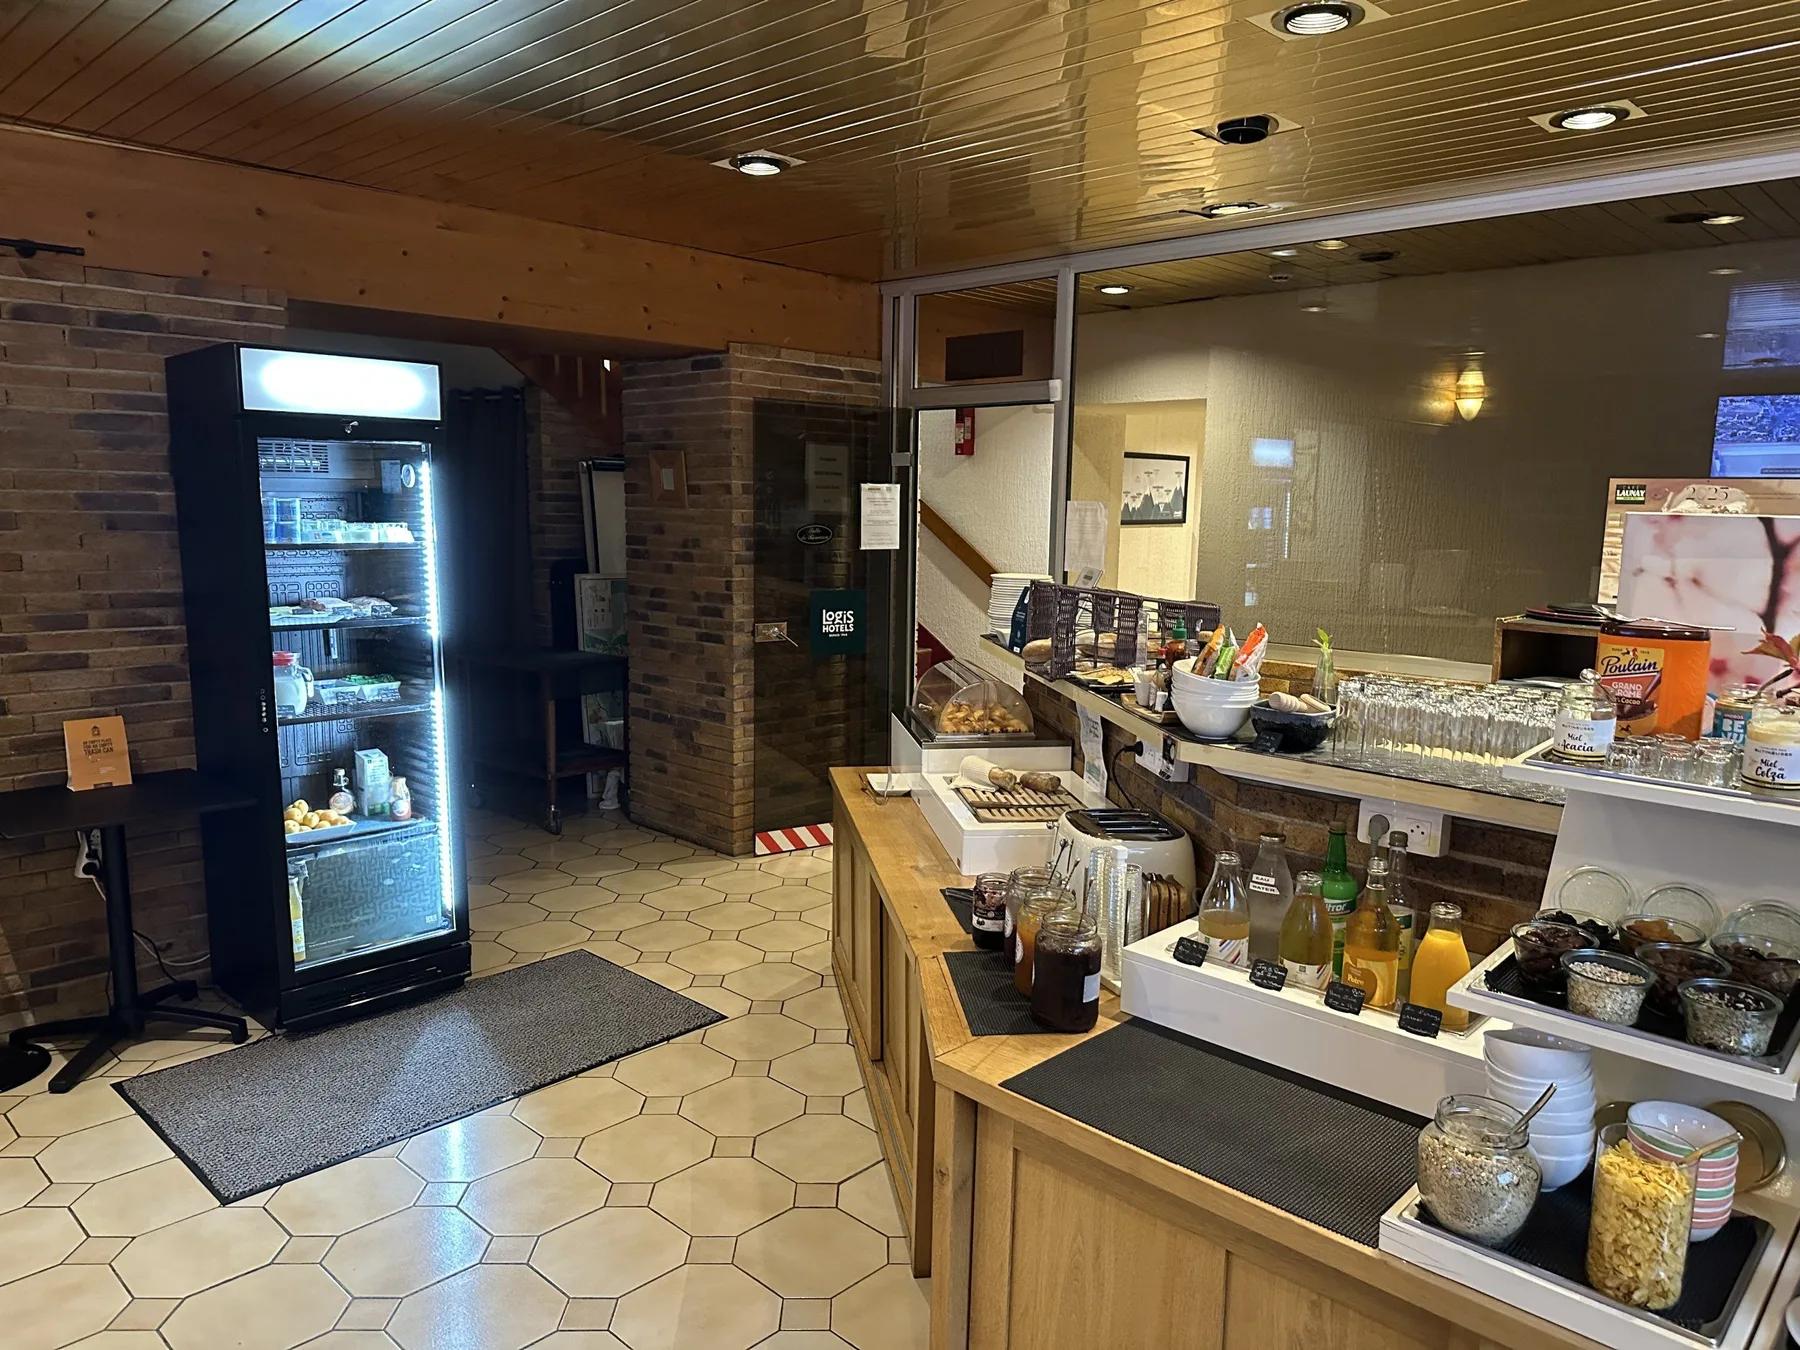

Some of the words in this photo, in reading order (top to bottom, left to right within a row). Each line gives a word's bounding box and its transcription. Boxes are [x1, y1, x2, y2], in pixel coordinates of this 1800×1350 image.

[1616, 489, 1646, 497] LAUNAY
[1686, 486, 1729, 501] 2025
[822, 623, 854, 633] HOTELS
[1601, 655, 1658, 675] Poulain
[1611, 681, 1643, 691] GRAND
[1567, 732, 1583, 742] Miel
[1760, 758, 1778, 768] Miel
[1755, 765, 1787, 781] Colza
[1252, 884, 1275, 893] WATER
[1347, 973, 1365, 986] Poire
